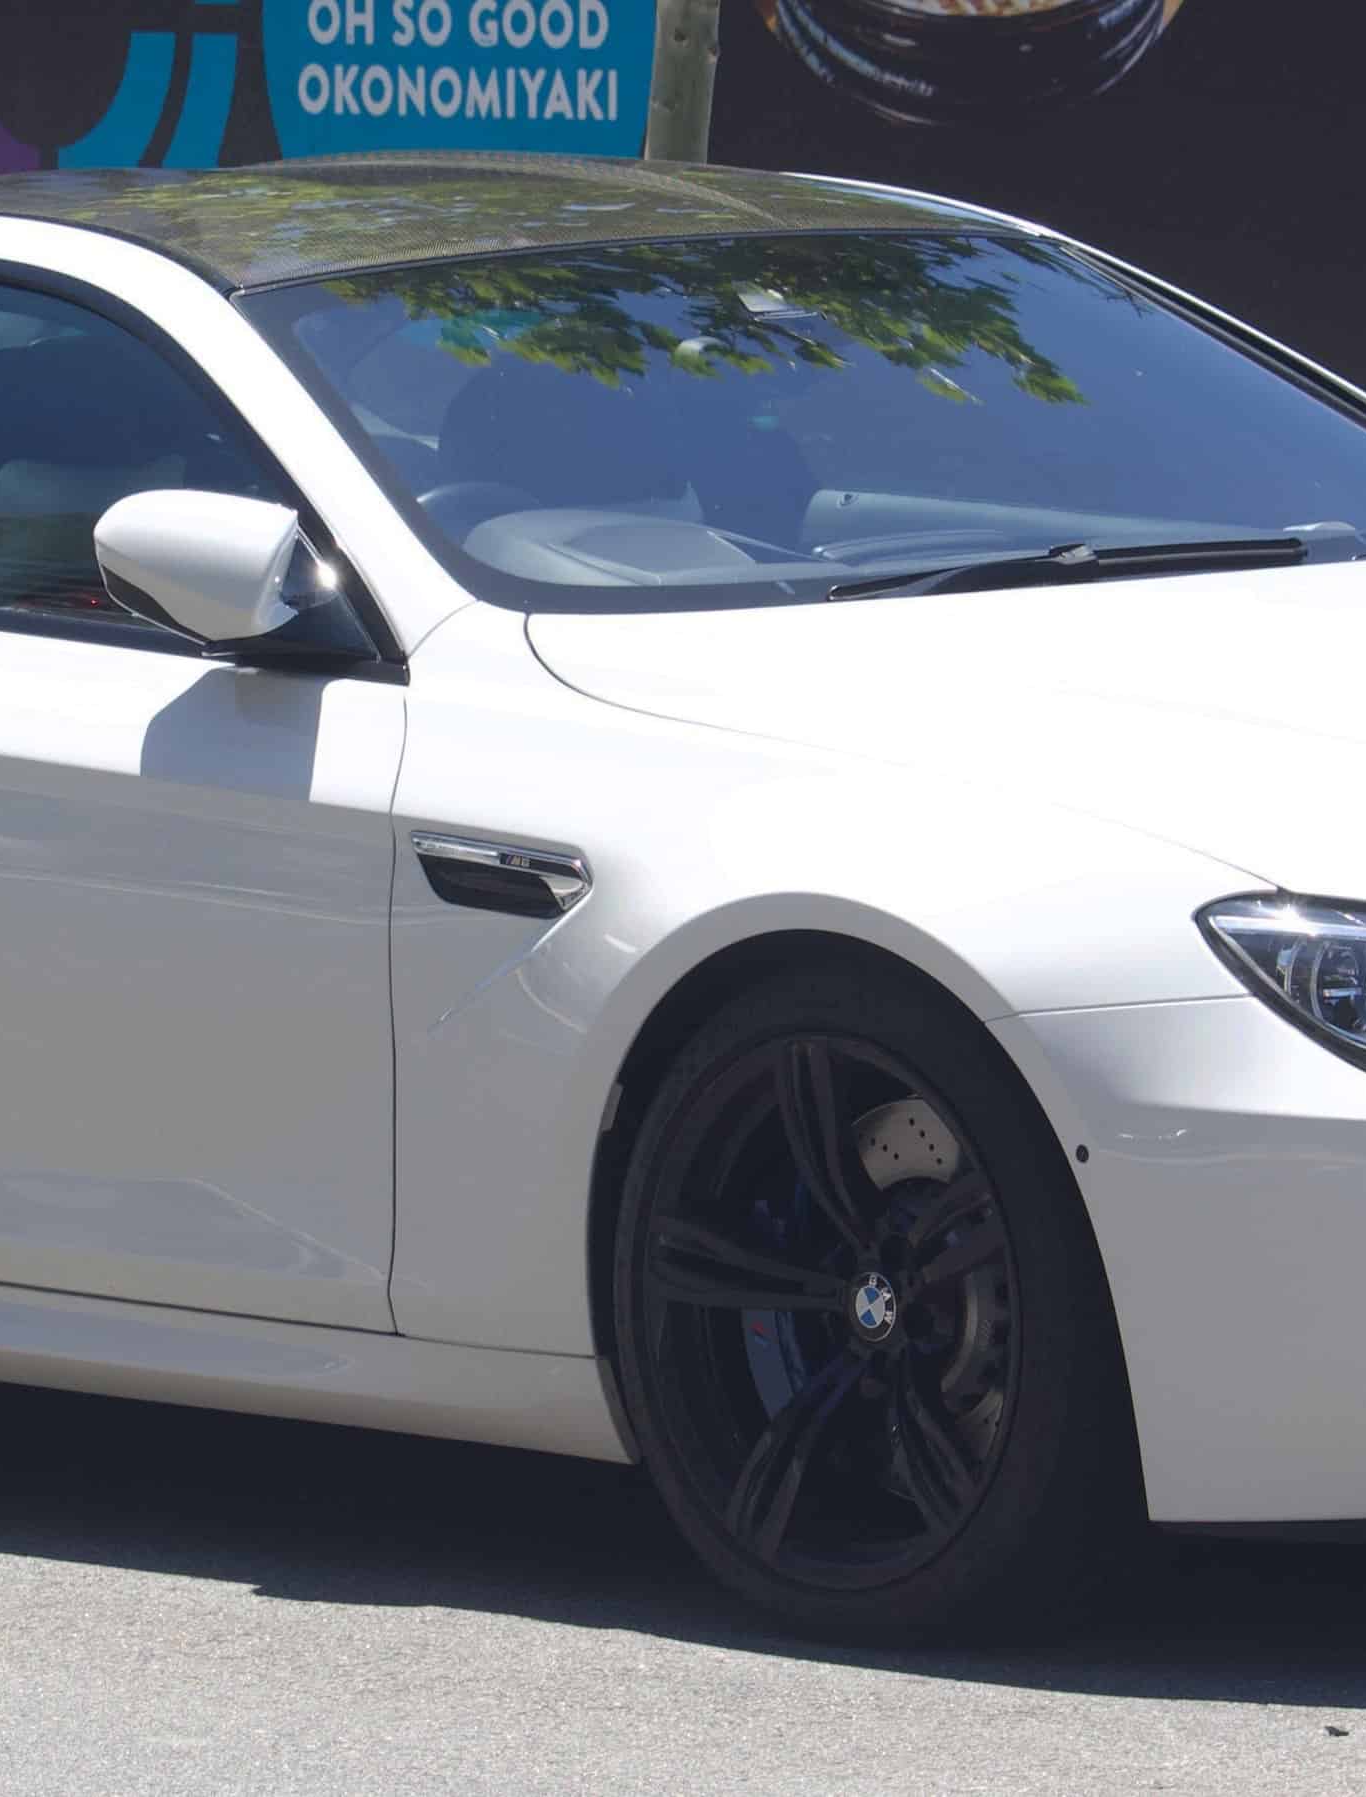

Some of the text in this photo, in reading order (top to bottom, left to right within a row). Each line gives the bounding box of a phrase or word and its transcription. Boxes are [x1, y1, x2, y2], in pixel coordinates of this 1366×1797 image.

[308, 0, 609, 48] OH SO GOOD
[298, 63, 619, 121] OKONOMIYAKI
